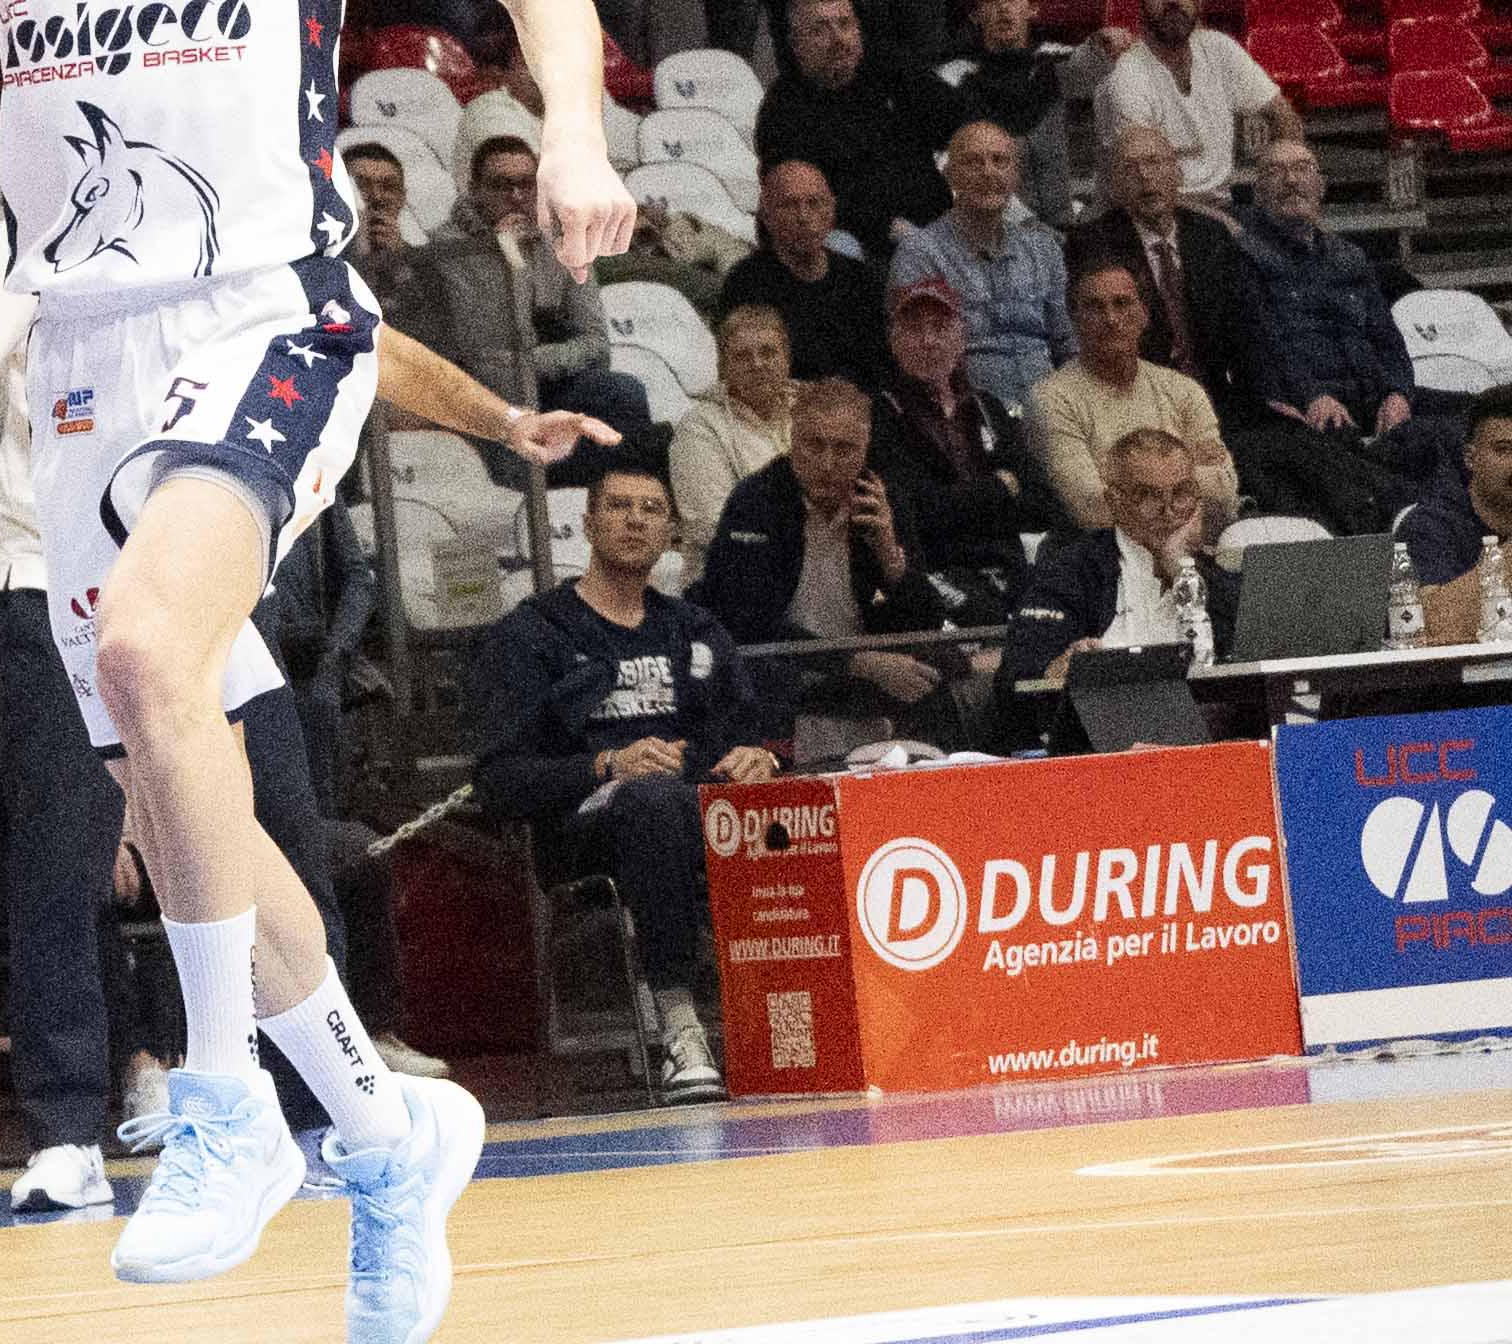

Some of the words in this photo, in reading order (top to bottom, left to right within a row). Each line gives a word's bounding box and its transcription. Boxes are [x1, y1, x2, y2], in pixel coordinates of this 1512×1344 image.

[2, 61, 94, 89] PIACENZA
[143, 45, 246, 67] BASKET
[162, 377, 209, 433] 5
[1355, 740, 1477, 788] UCC
[979, 836, 1273, 934] DURING
[729, 936, 840, 960] WWW.DURING.IT
[983, 936, 1098, 976] Agenzia
[1106, 934, 1154, 965] per
[1161, 928, 1178, 955] il
[1186, 921, 1281, 953] Lavoro
[327, 1010, 364, 1066] CRAFT
[988, 1034, 1160, 1075] www.during.it
